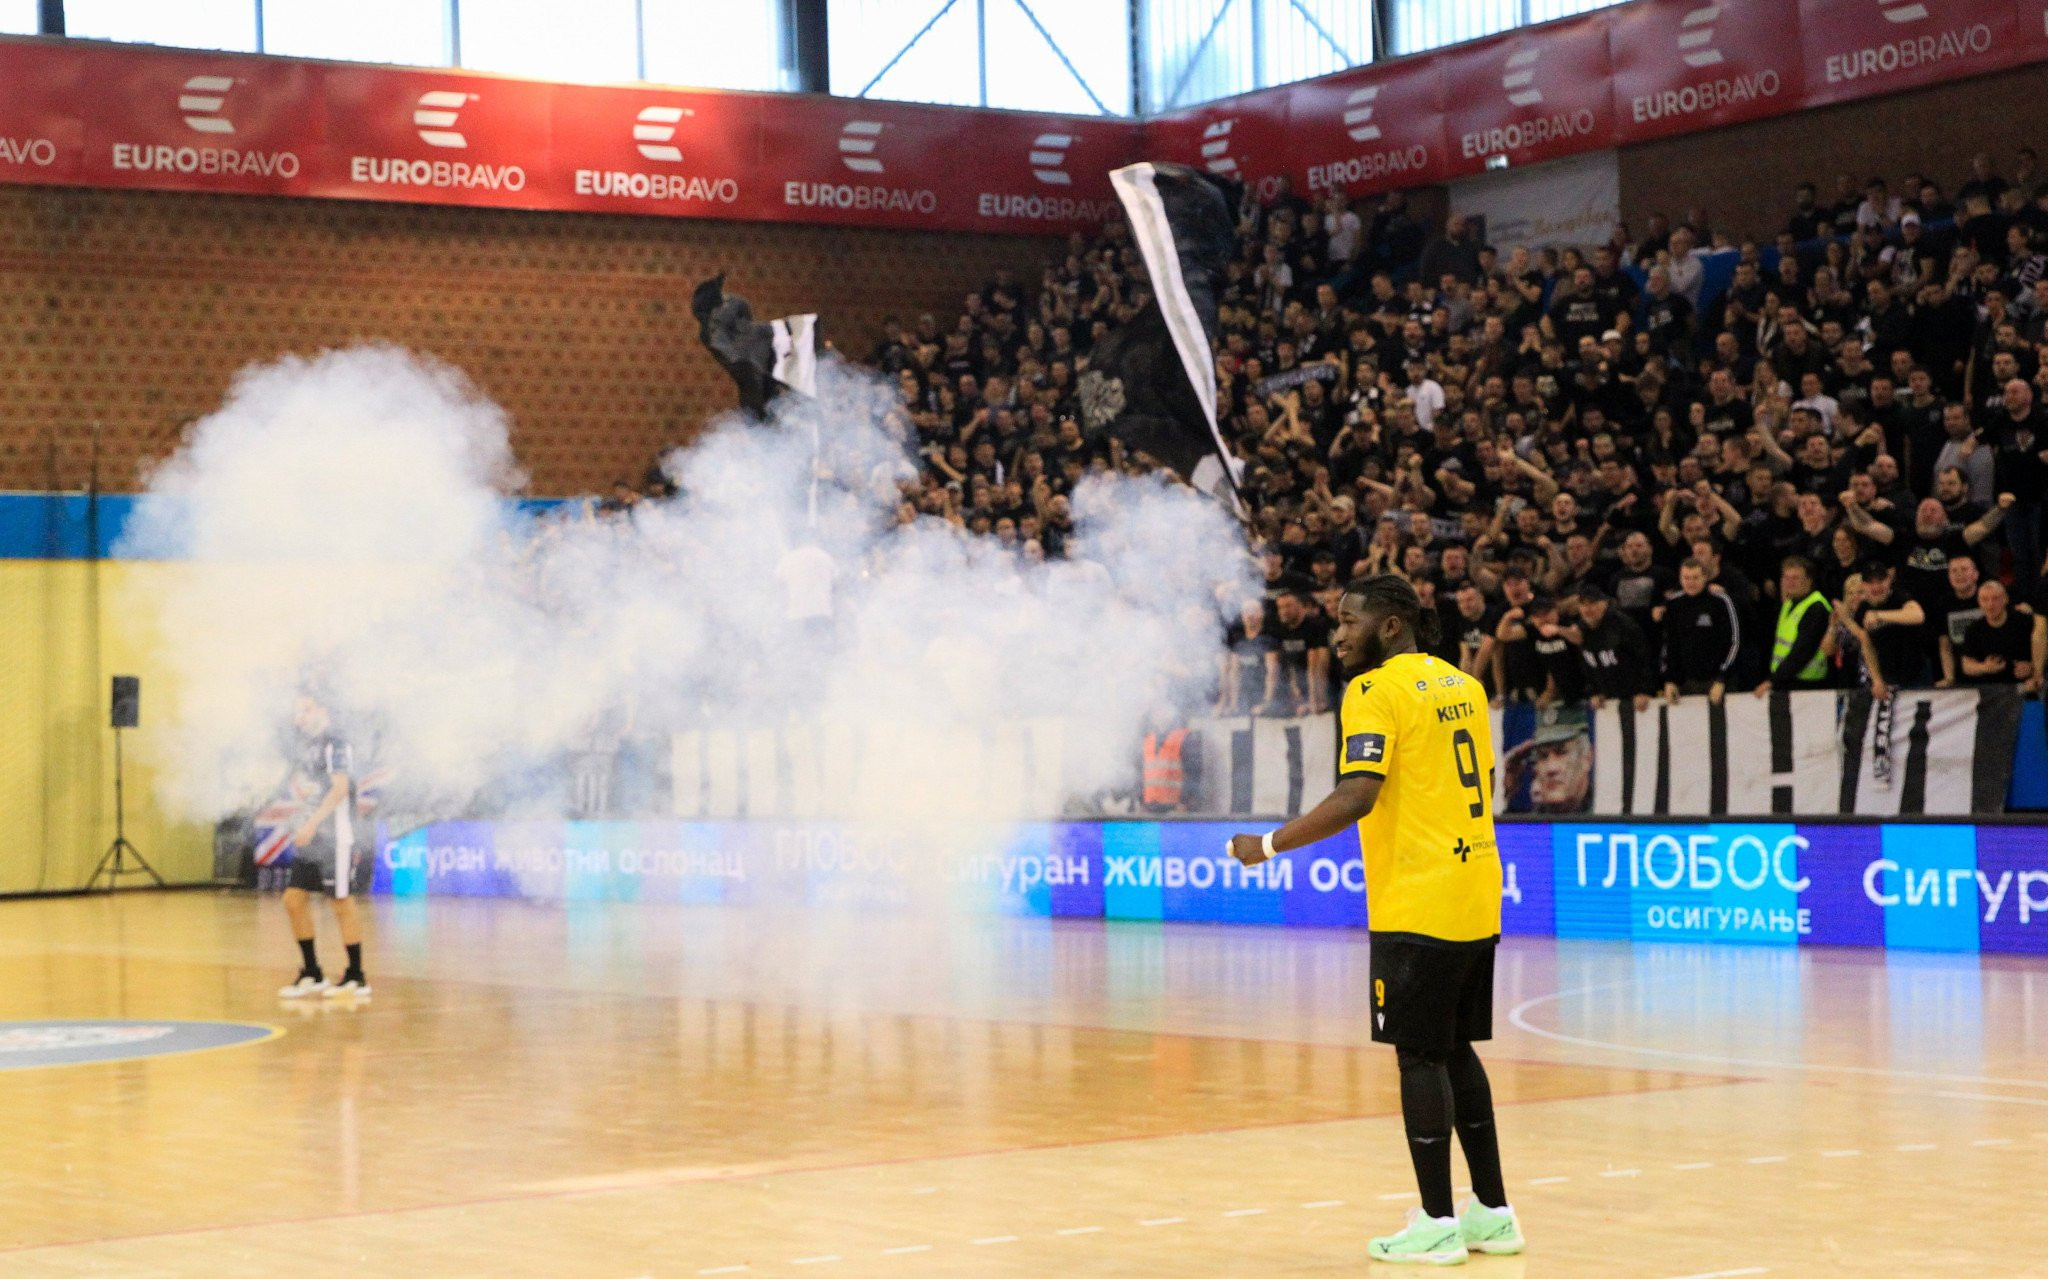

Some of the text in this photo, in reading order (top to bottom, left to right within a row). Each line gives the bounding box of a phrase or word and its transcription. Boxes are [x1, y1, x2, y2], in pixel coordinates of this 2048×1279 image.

[1825, 23, 1991, 83] EUROBRAVO
[1632, 69, 1780, 123] EUROBRAVO
[1461, 109, 1594, 160] EUROBRAVO
[112, 142, 299, 178] EUROBRAVO
[351, 157, 526, 192] EUROBRAVO
[1307, 145, 1427, 191] EUROBRAVO
[575, 169, 738, 203] EUROBRAVO
[784, 181, 937, 214] EUROBRAVO
[1436, 702, 1475, 724] KEITA
[1453, 728, 1484, 819] 9
[1576, 833, 1812, 890] ГЛОБОС
[1647, 904, 1812, 934] ОСИГУРАЊЕ
[1374, 978, 1385, 1008] 9
